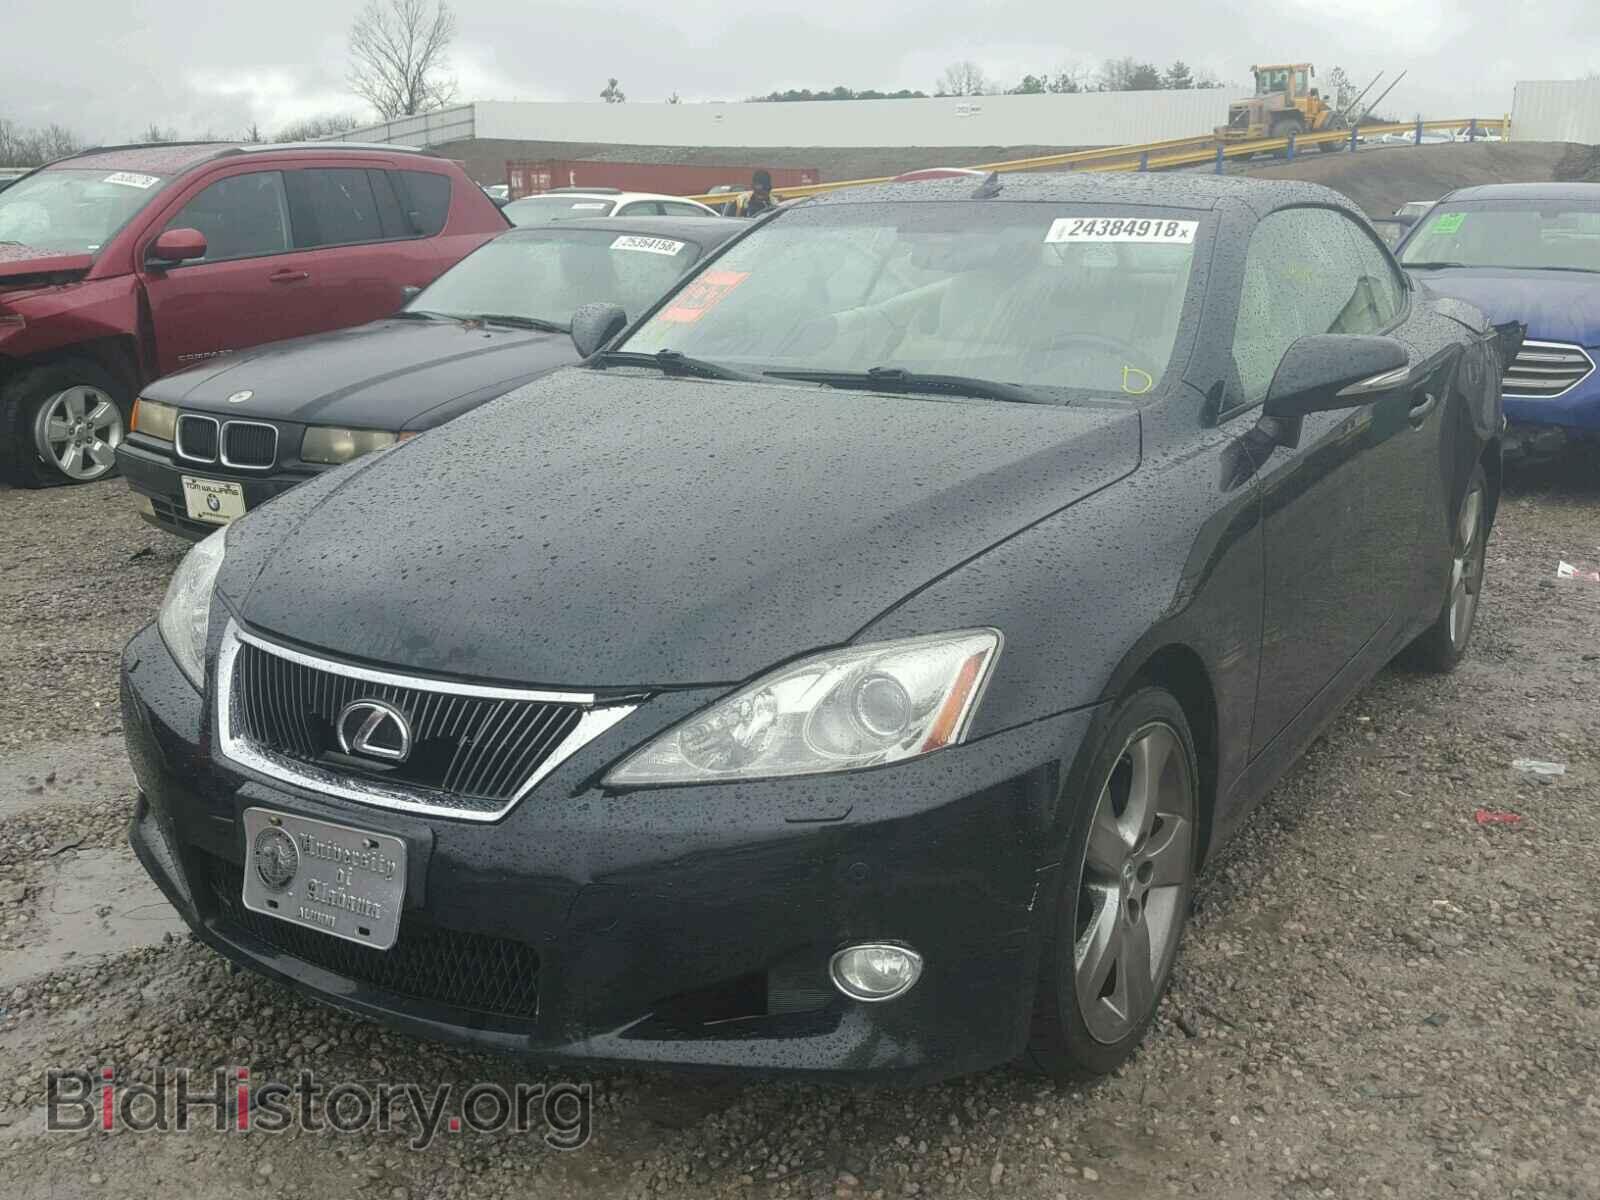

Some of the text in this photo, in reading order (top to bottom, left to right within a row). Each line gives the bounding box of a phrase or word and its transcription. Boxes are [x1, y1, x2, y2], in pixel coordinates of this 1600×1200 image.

[177, 349, 233, 361] COMPA
[186, 482, 239, 496] TOM WILLIAMS
[299, 832, 396, 881] University
[336, 867, 353, 886] of
[307, 878, 382, 920] Alabama
[299, 906, 336, 928] ALUMNI
